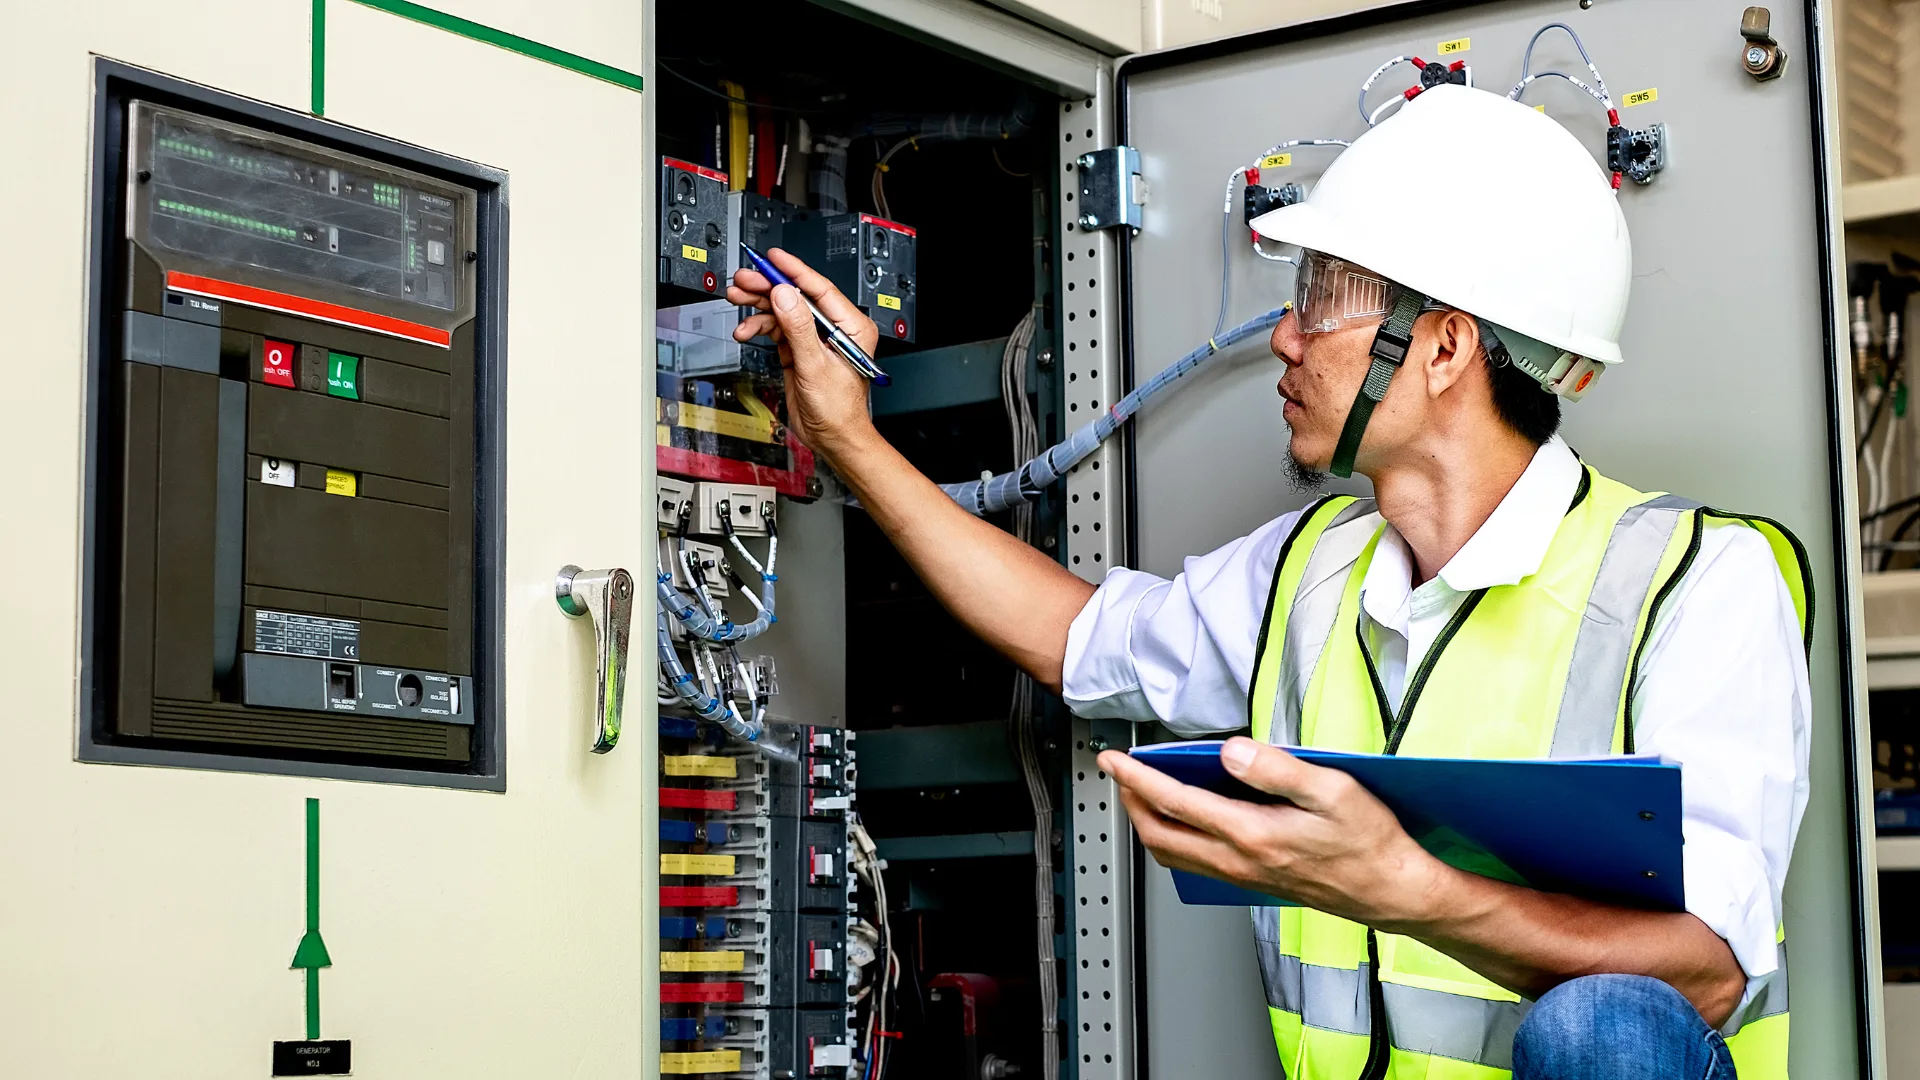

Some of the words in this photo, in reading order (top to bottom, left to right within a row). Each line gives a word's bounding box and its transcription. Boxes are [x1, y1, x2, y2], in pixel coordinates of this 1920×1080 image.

[1445, 41, 1461, 52] SW1
[1630, 91, 1650, 104] SW5
[1267, 156, 1284, 166] SW2
[690, 249, 699, 258] Q1
[884, 297, 893, 307] Q2
[202, 302, 220, 313] Reset
[276, 368, 291, 377] OFF
[342, 380, 354, 389] ON
[268, 472, 280, 480] OFF
[425, 675, 448, 683] CONNECTED
